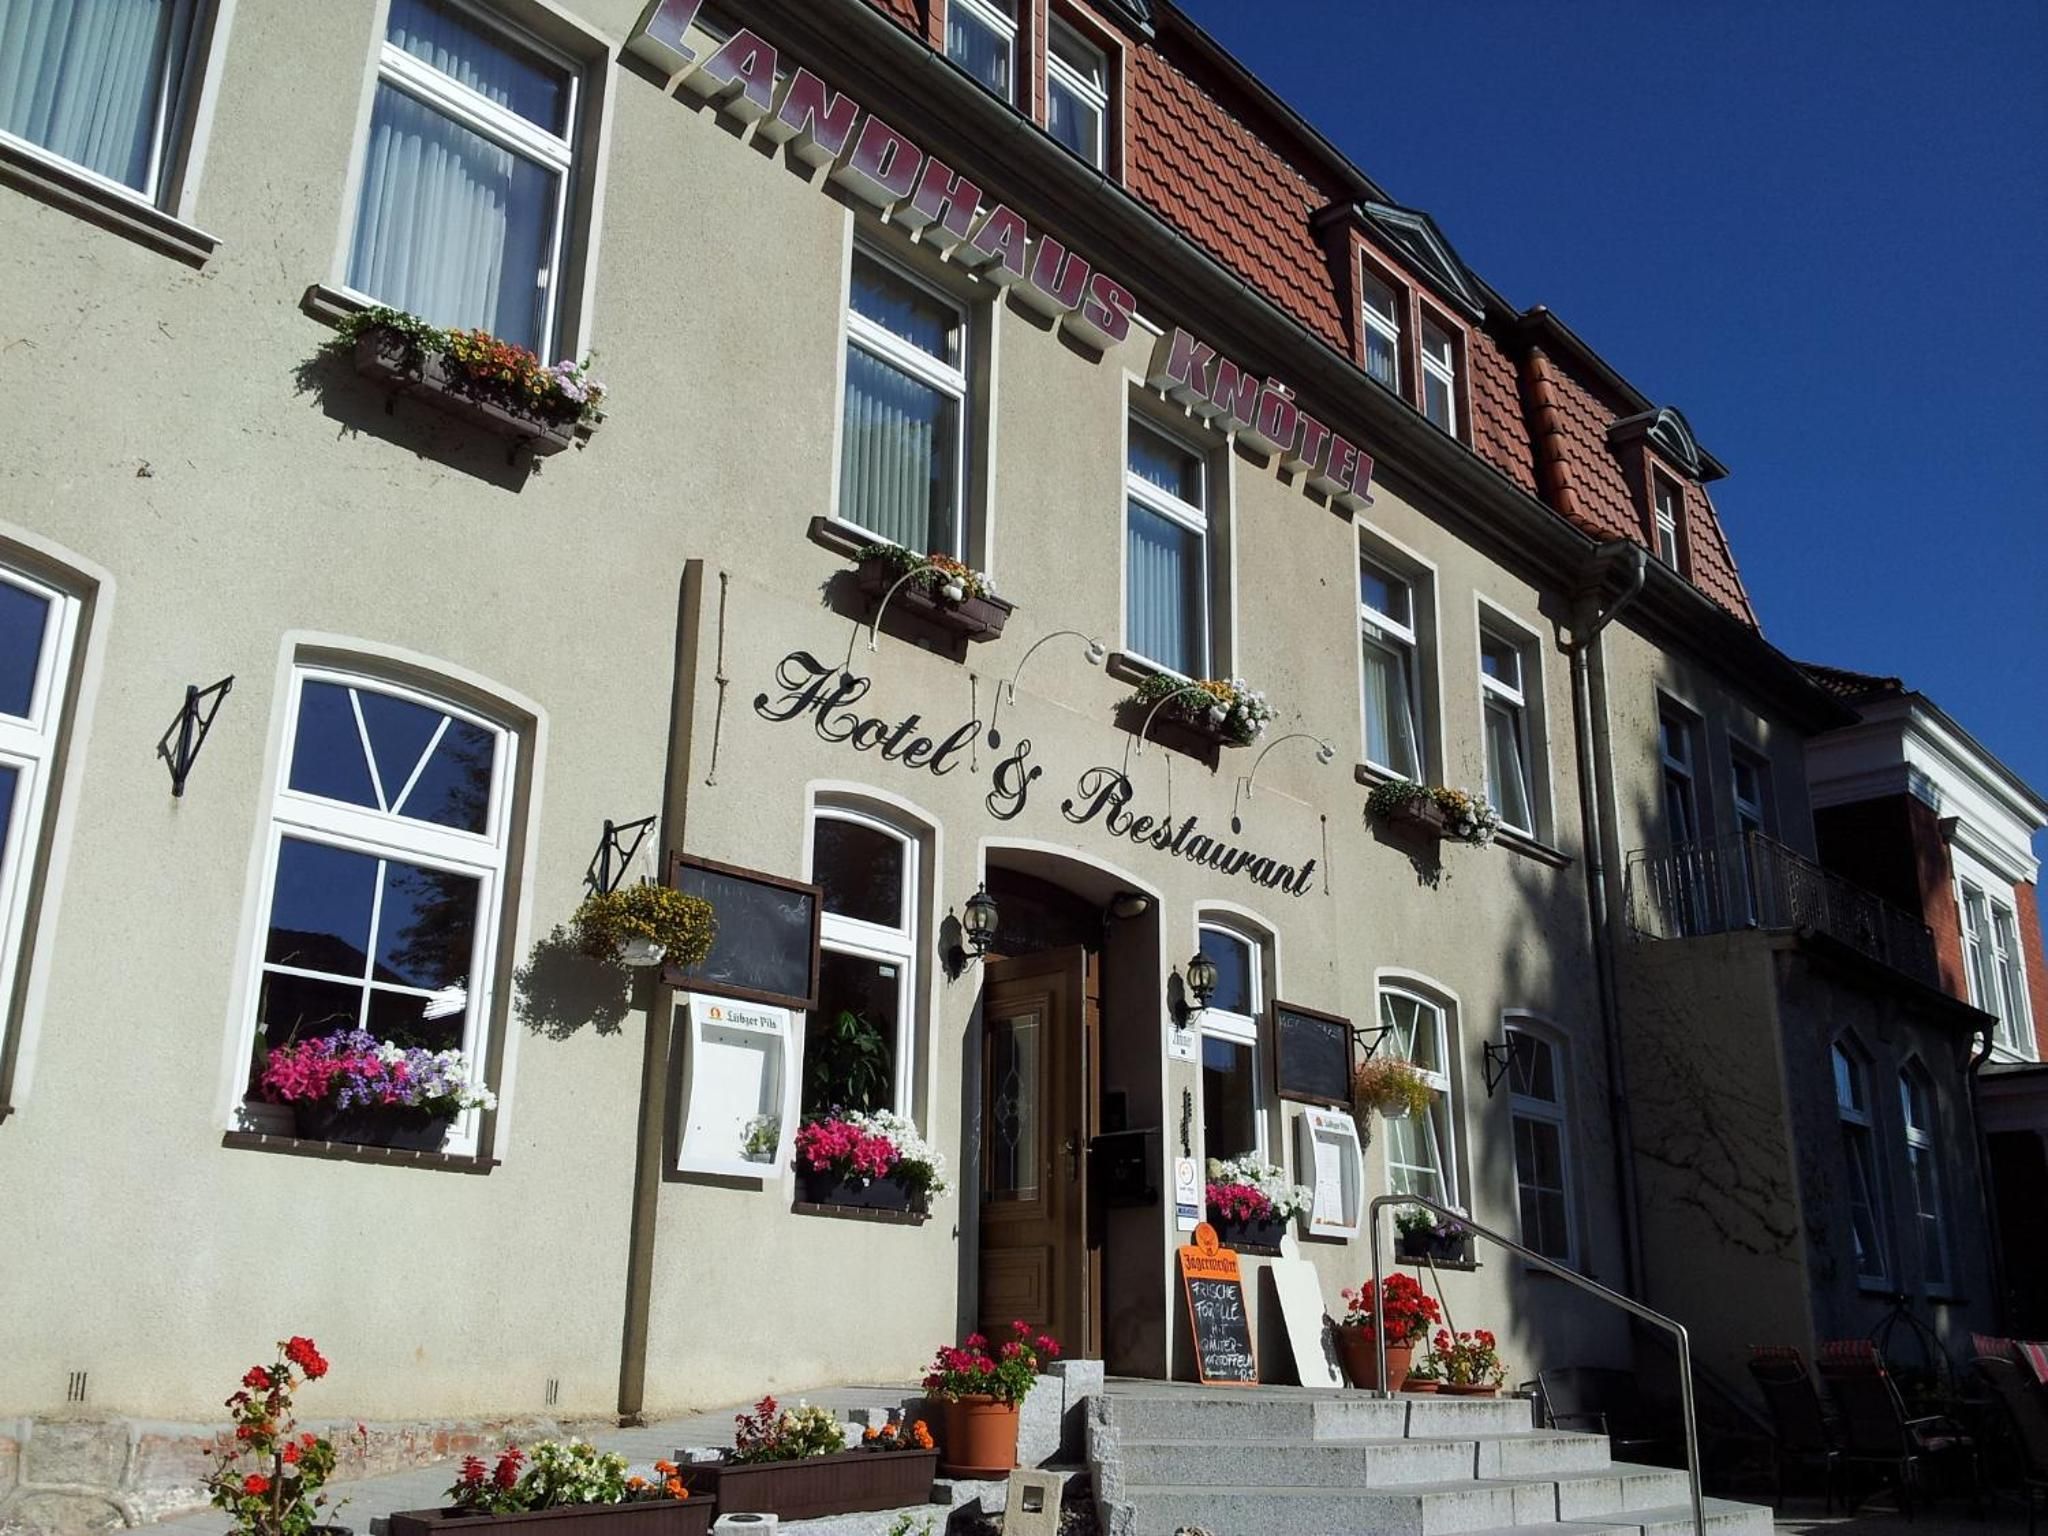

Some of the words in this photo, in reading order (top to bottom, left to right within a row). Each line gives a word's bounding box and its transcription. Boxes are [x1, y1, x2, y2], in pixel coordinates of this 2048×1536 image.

[645, 0, 1137, 345] LANDHAUS
[1166, 327, 1375, 504] KNÖTEL
[754, 650, 982, 775] Hotel
[986, 738, 1042, 821] &
[1061, 766, 1317, 898] Restaurant
[1191, 1281, 1238, 1300] FRISCHE
